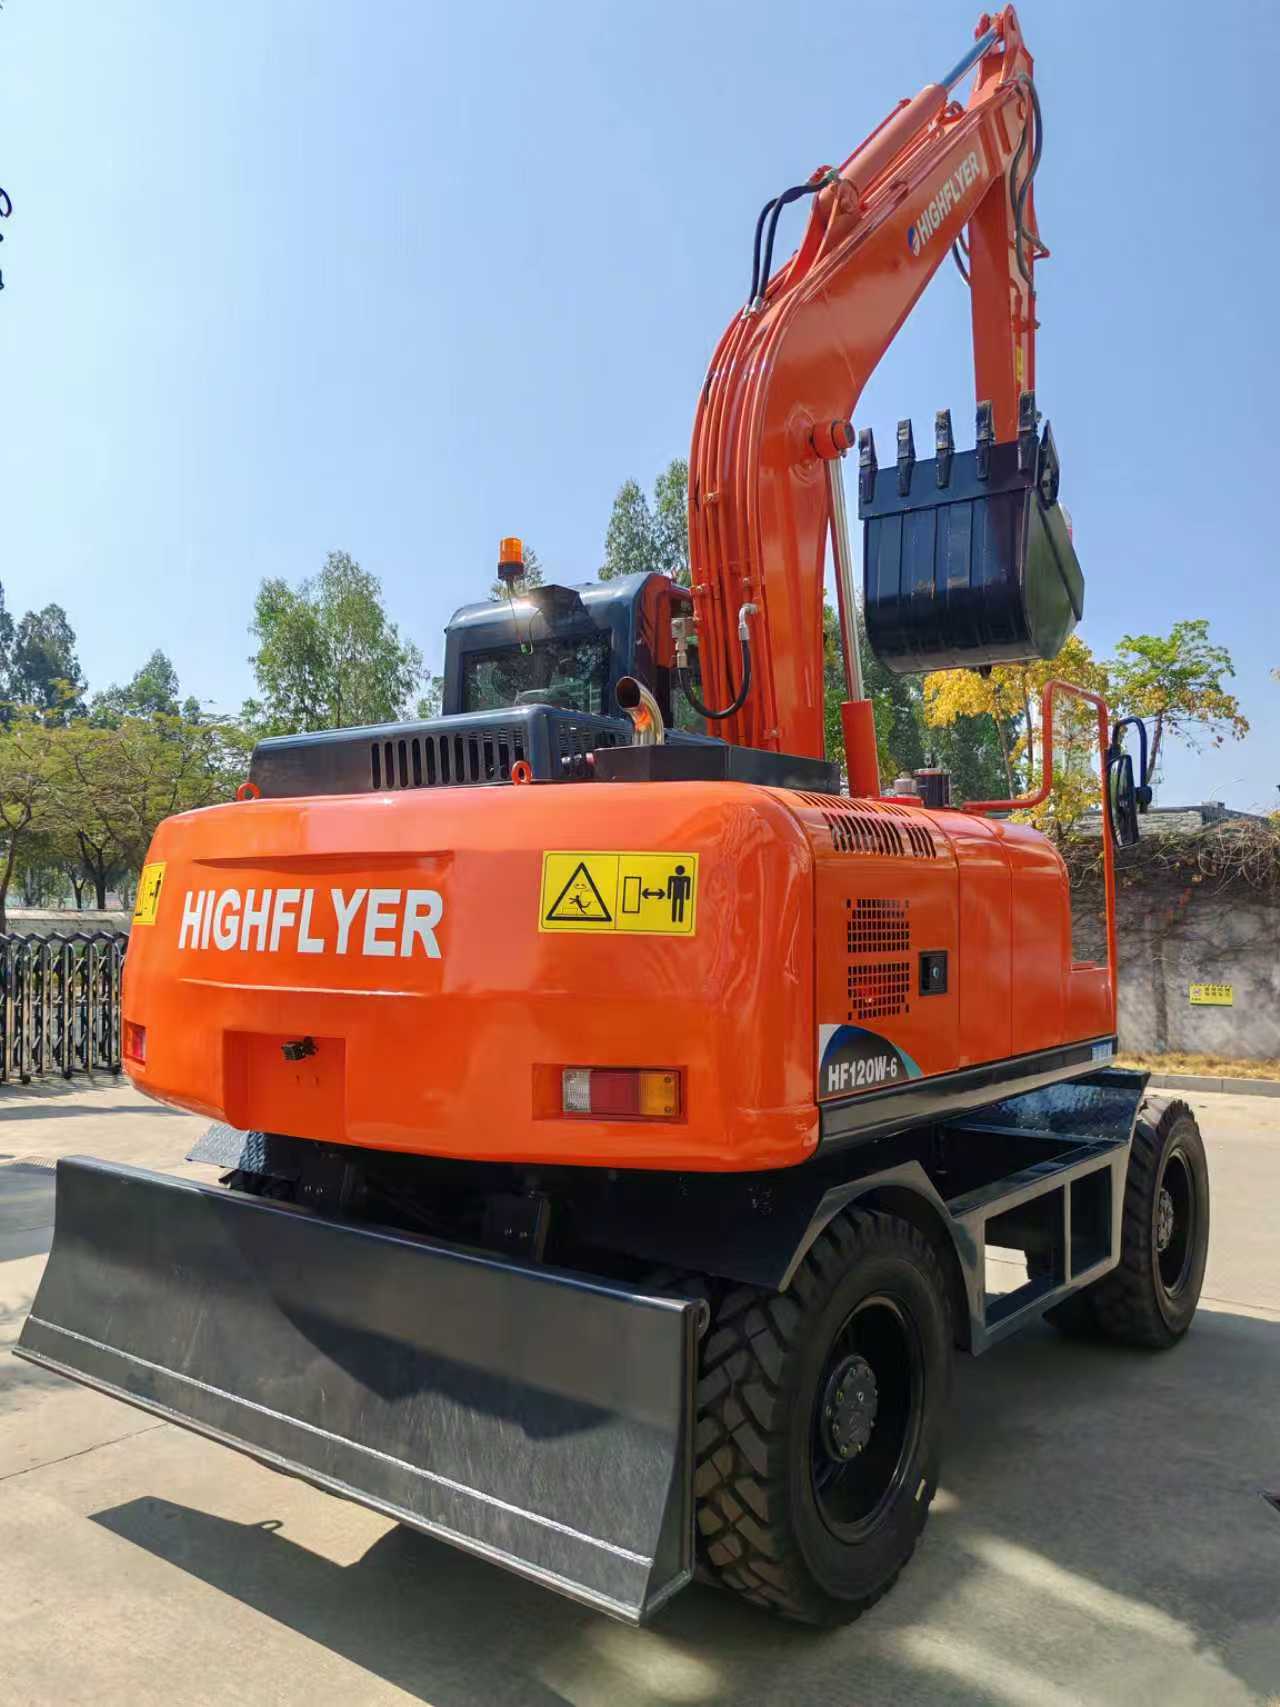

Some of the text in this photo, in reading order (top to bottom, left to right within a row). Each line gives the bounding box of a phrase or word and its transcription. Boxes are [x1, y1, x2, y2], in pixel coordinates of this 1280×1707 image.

[916, 152, 981, 246] HIGHFLYER
[178, 888, 443, 958] HIGHFLYER
[828, 1055, 898, 1092] HF120W-6
